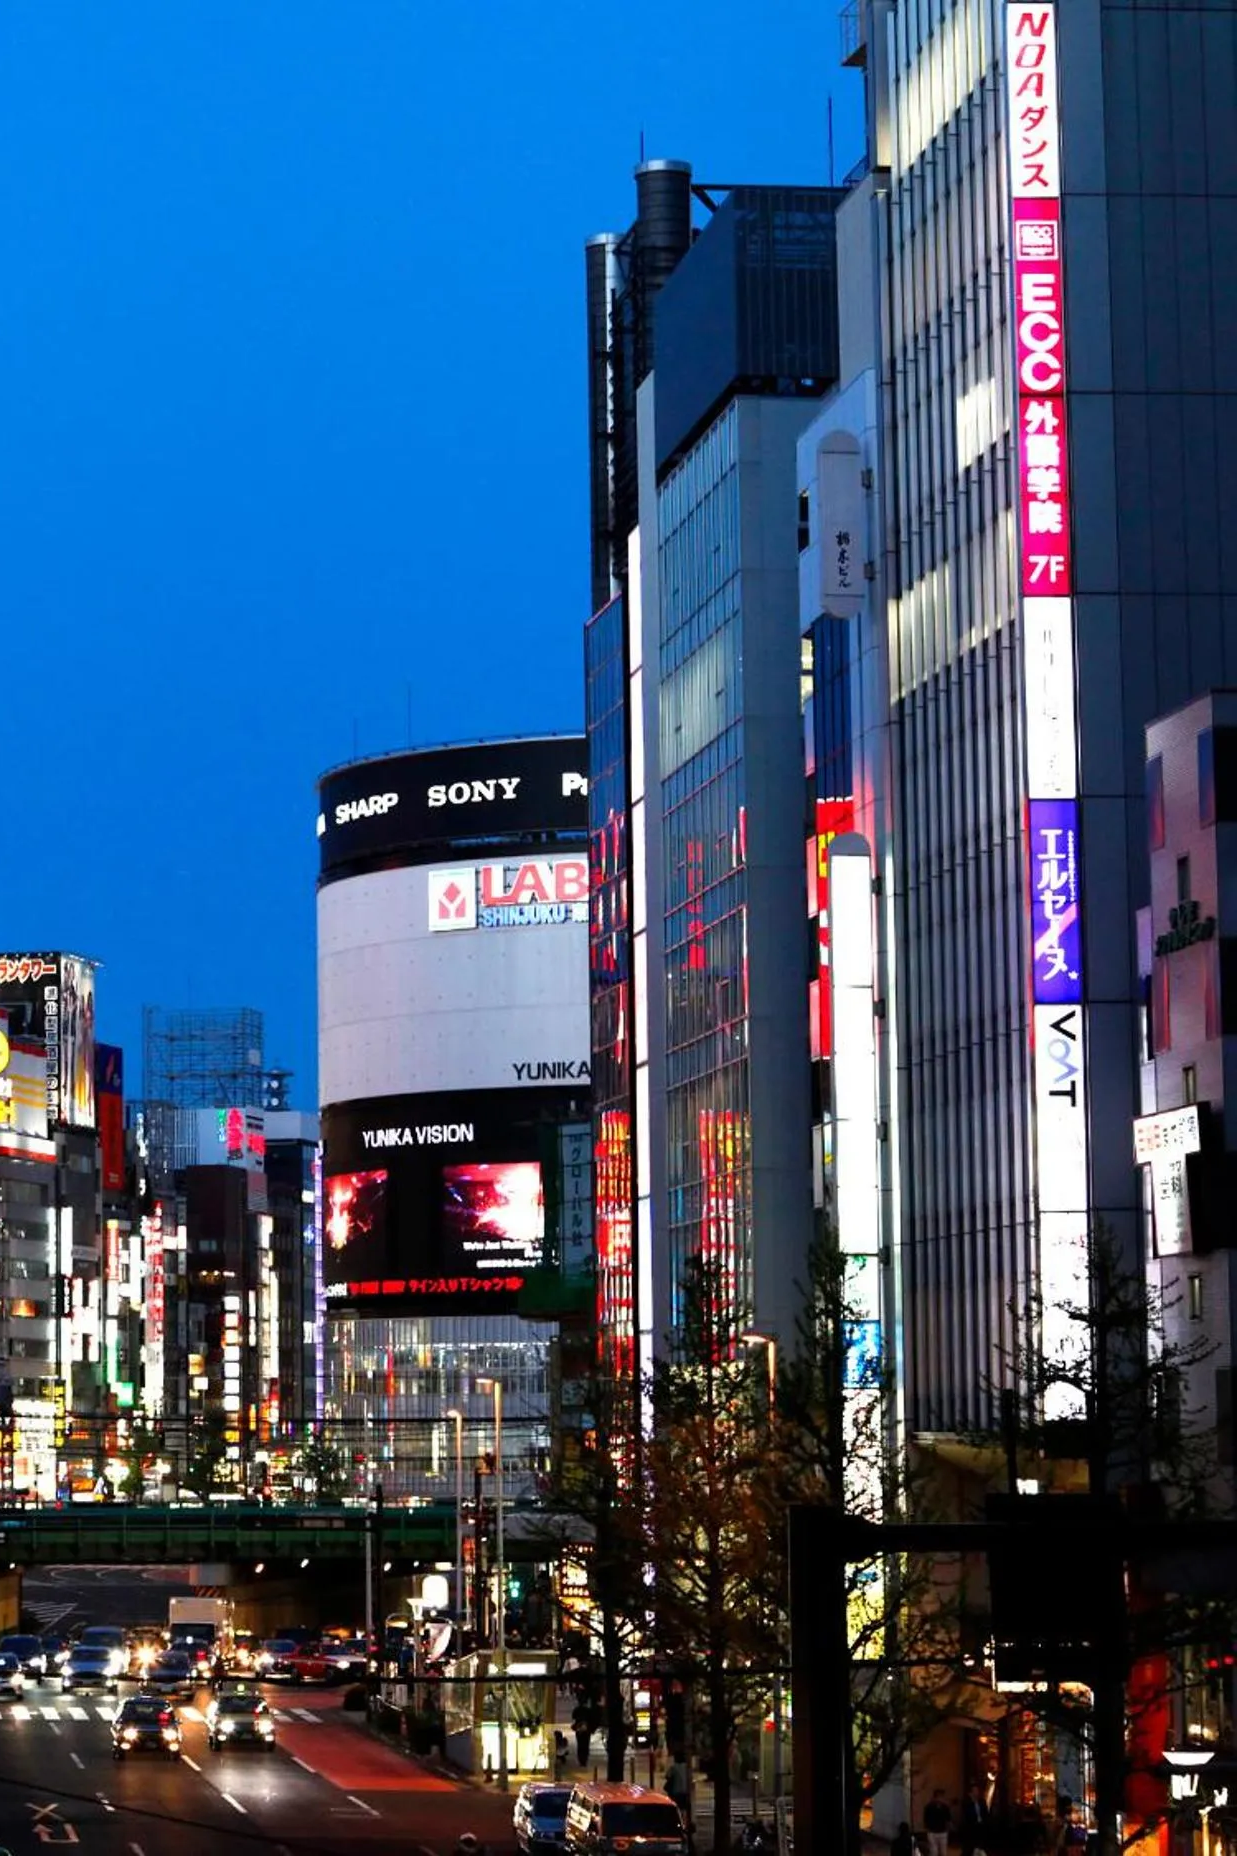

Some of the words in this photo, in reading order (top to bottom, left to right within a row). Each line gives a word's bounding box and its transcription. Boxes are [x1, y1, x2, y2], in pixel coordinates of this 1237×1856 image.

[1019, 273, 1061, 392] ECC
[1028, 555, 1065, 583] 7F
[427, 777, 521, 808] SONY
[334, 792, 399, 825] SHARP
[512, 1060, 591, 1081] YUNIKA
[363, 1127, 413, 1149] YUNIKA
[415, 1123, 475, 1145] VISION
